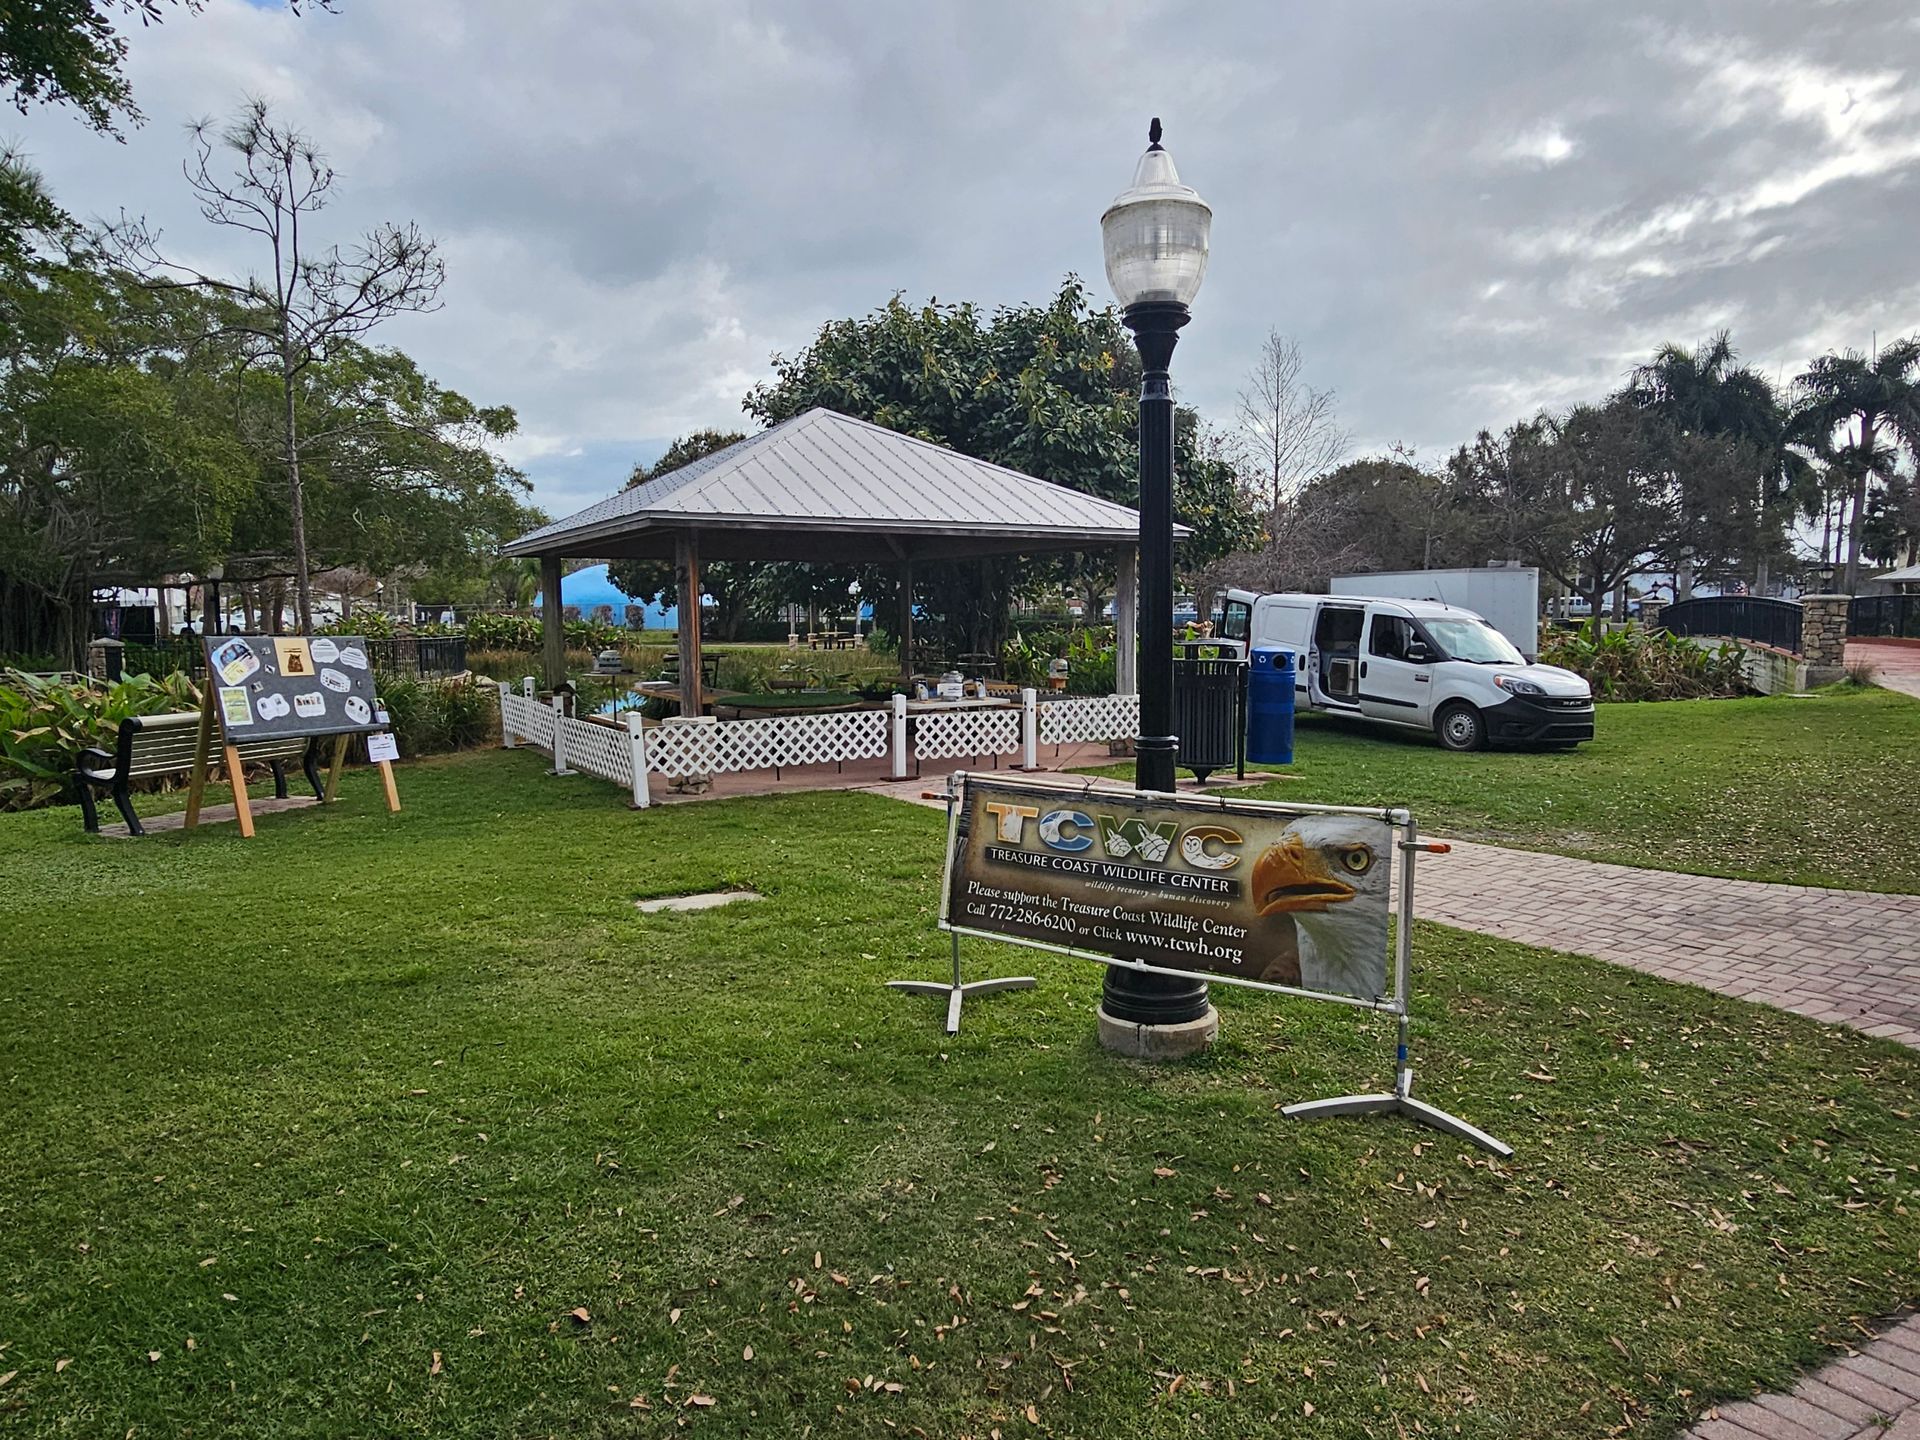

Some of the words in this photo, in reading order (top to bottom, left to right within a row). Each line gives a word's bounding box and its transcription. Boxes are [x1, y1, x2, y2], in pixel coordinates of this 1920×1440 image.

[986, 801, 1243, 870] TCWC
[991, 848, 1048, 867] TREASURE
[1052, 858, 1098, 874] COAST
[1102, 865, 1166, 884] WILDLIFE
[1171, 874, 1229, 893] CENTER
[1085, 881, 1115, 891] wildlife
[1117, 886, 1149, 898] recovery
[1158, 890, 1186, 902] human
[1189, 895, 1231, 909] discovery
[967, 880, 1001, 899] Please
[1002, 890, 1040, 906] support
[1042, 893, 1058, 909] the
[1060, 896, 1110, 918] Treasure
[1112, 905, 1146, 924] Coast
[1149, 910, 1199, 934] Wildlife
[1202, 918, 1248, 939] Center
[967, 902, 986, 916] Call
[989, 903, 1076, 933] 772-286-6200
[1078, 926, 1090, 935] or
[1093, 925, 1123, 941] Click
[1125, 931, 1243, 965] www.tcwh.org
